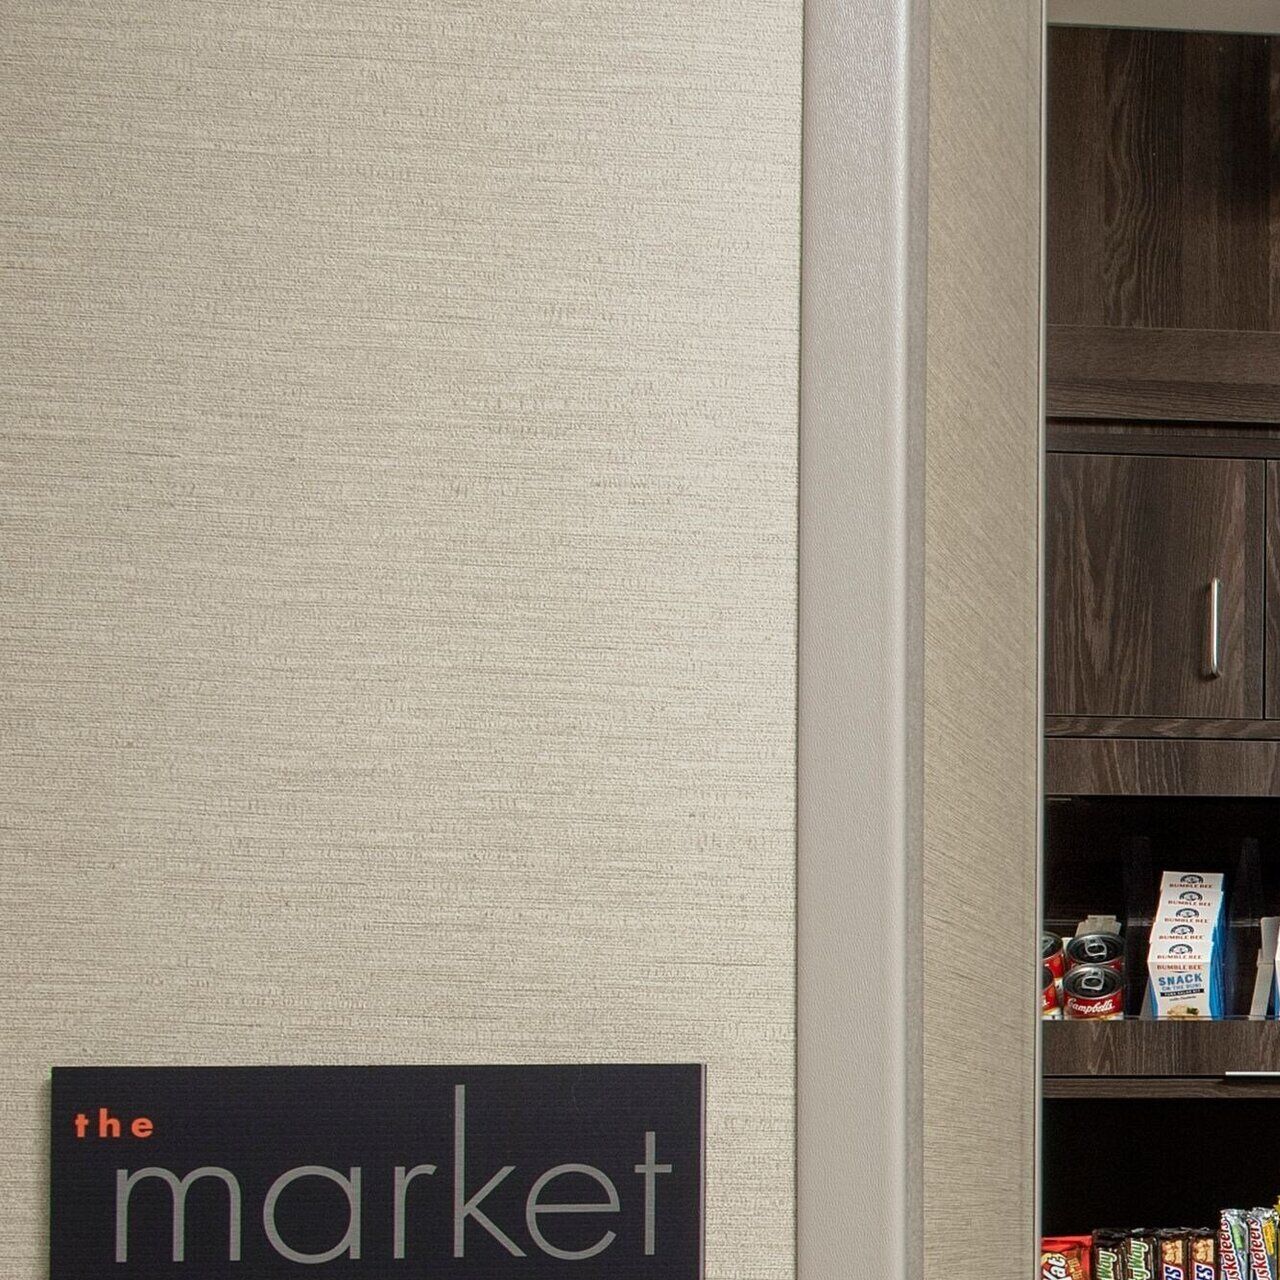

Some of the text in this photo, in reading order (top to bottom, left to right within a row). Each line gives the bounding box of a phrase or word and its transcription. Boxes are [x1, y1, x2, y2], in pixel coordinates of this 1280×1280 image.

[1159, 973, 1203, 986] SNACK
[75, 1108, 154, 1138] the
[115, 1084, 673, 1264] market
